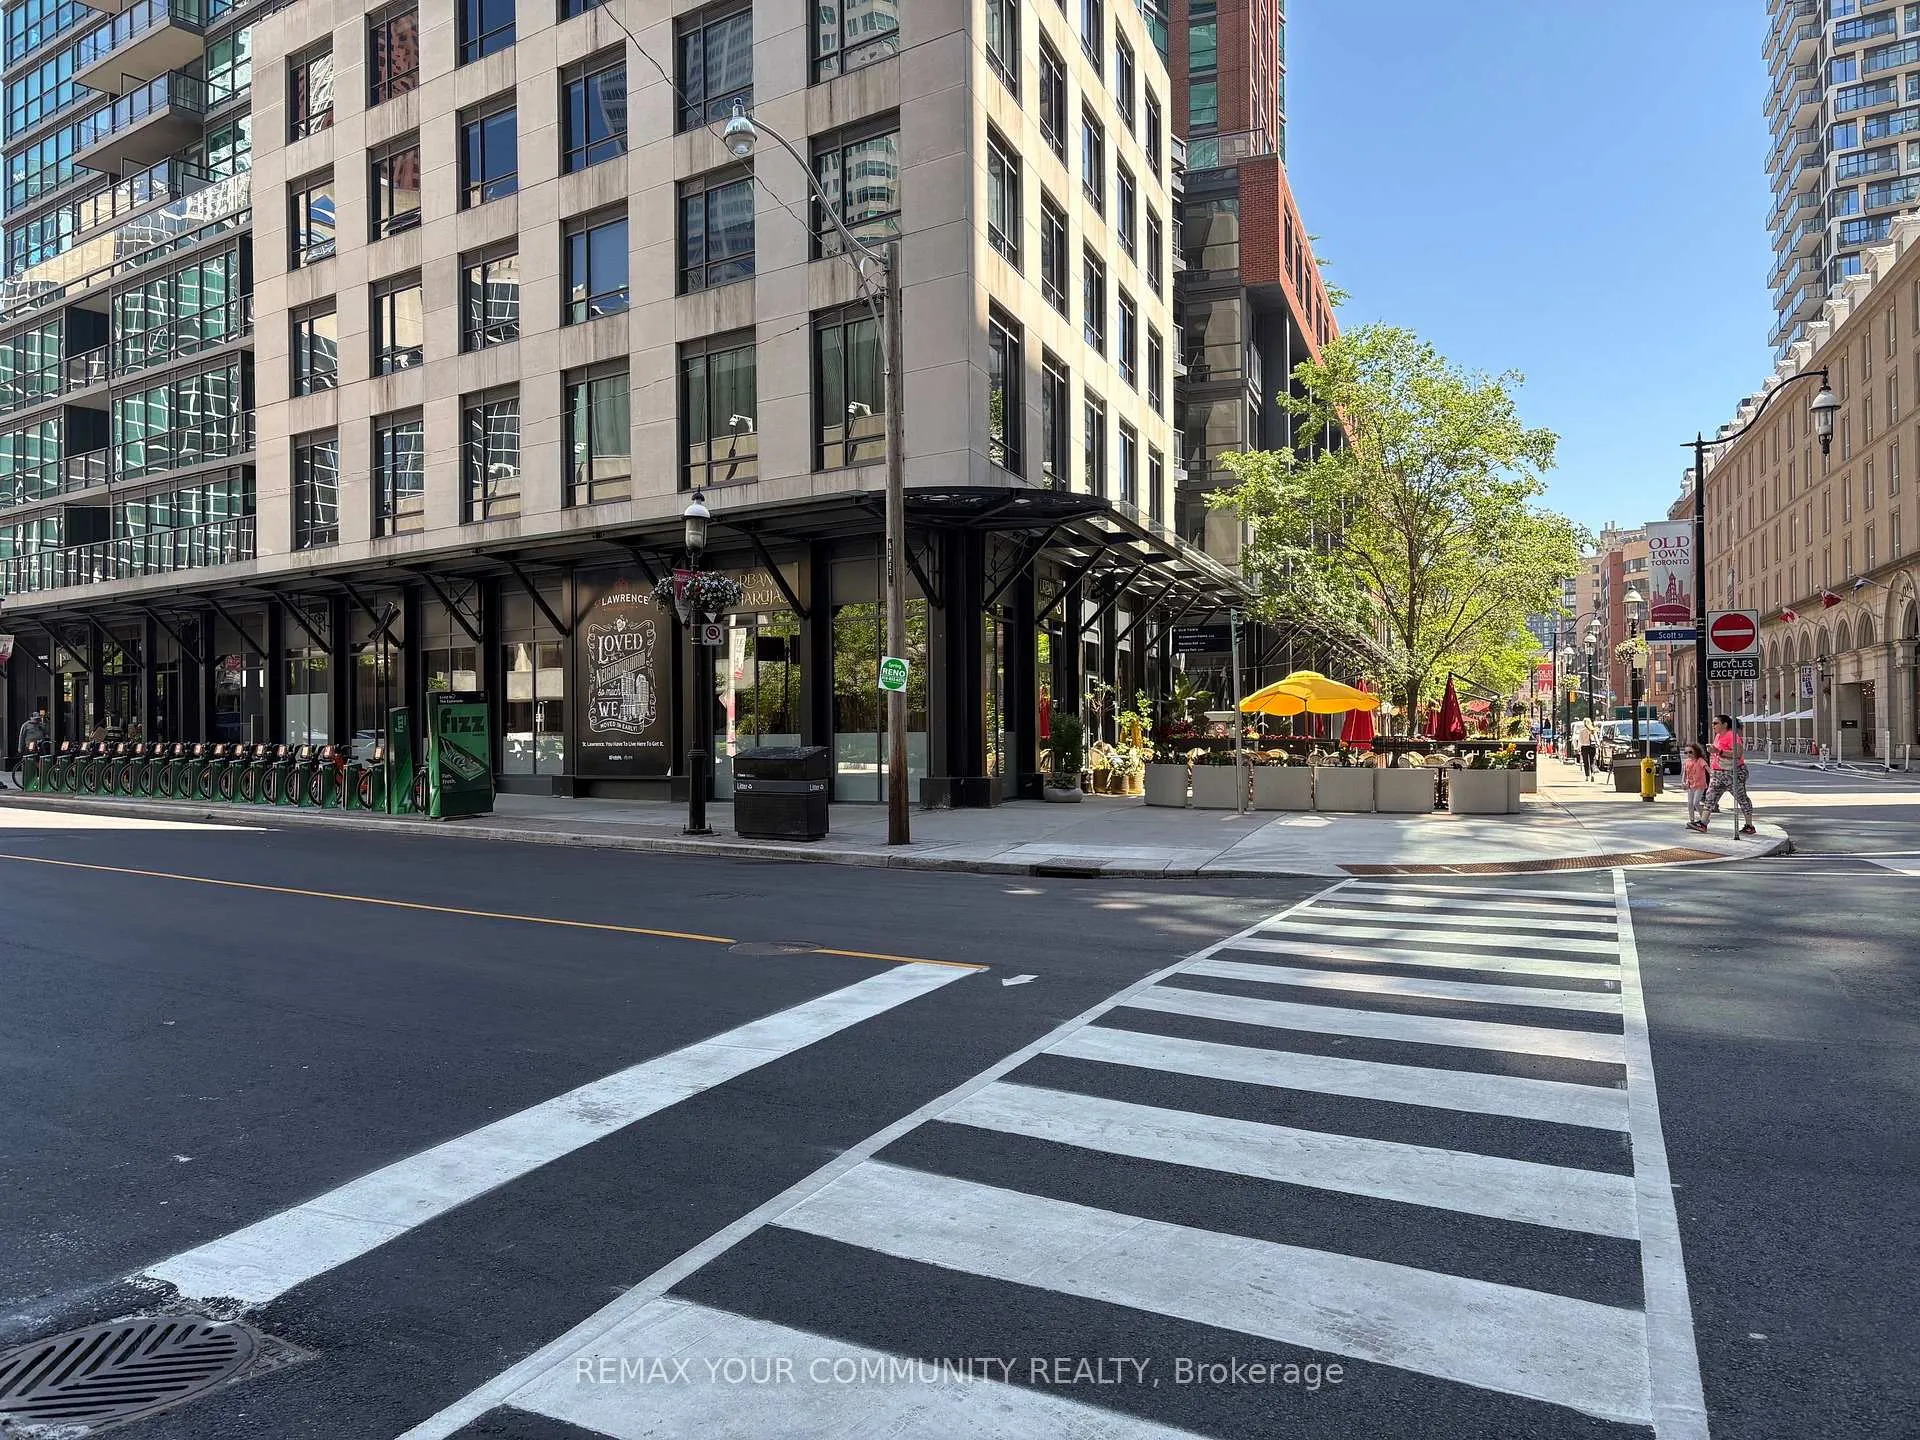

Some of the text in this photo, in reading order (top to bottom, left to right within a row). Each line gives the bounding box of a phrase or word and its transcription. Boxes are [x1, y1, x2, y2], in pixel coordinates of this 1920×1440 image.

[1649, 536, 1690, 549] OLD
[1649, 549, 1689, 559] TOWN
[739, 573, 773, 588] RBAN
[601, 593, 649, 606] LAWRENCE
[1658, 632, 1677, 640] Scott
[597, 632, 643, 664] LOVED
[1713, 660, 1754, 669] BICYCLES
[882, 667, 907, 677] RENO
[1711, 669, 1756, 678] EXCEPTED
[598, 701, 619, 717] WE
